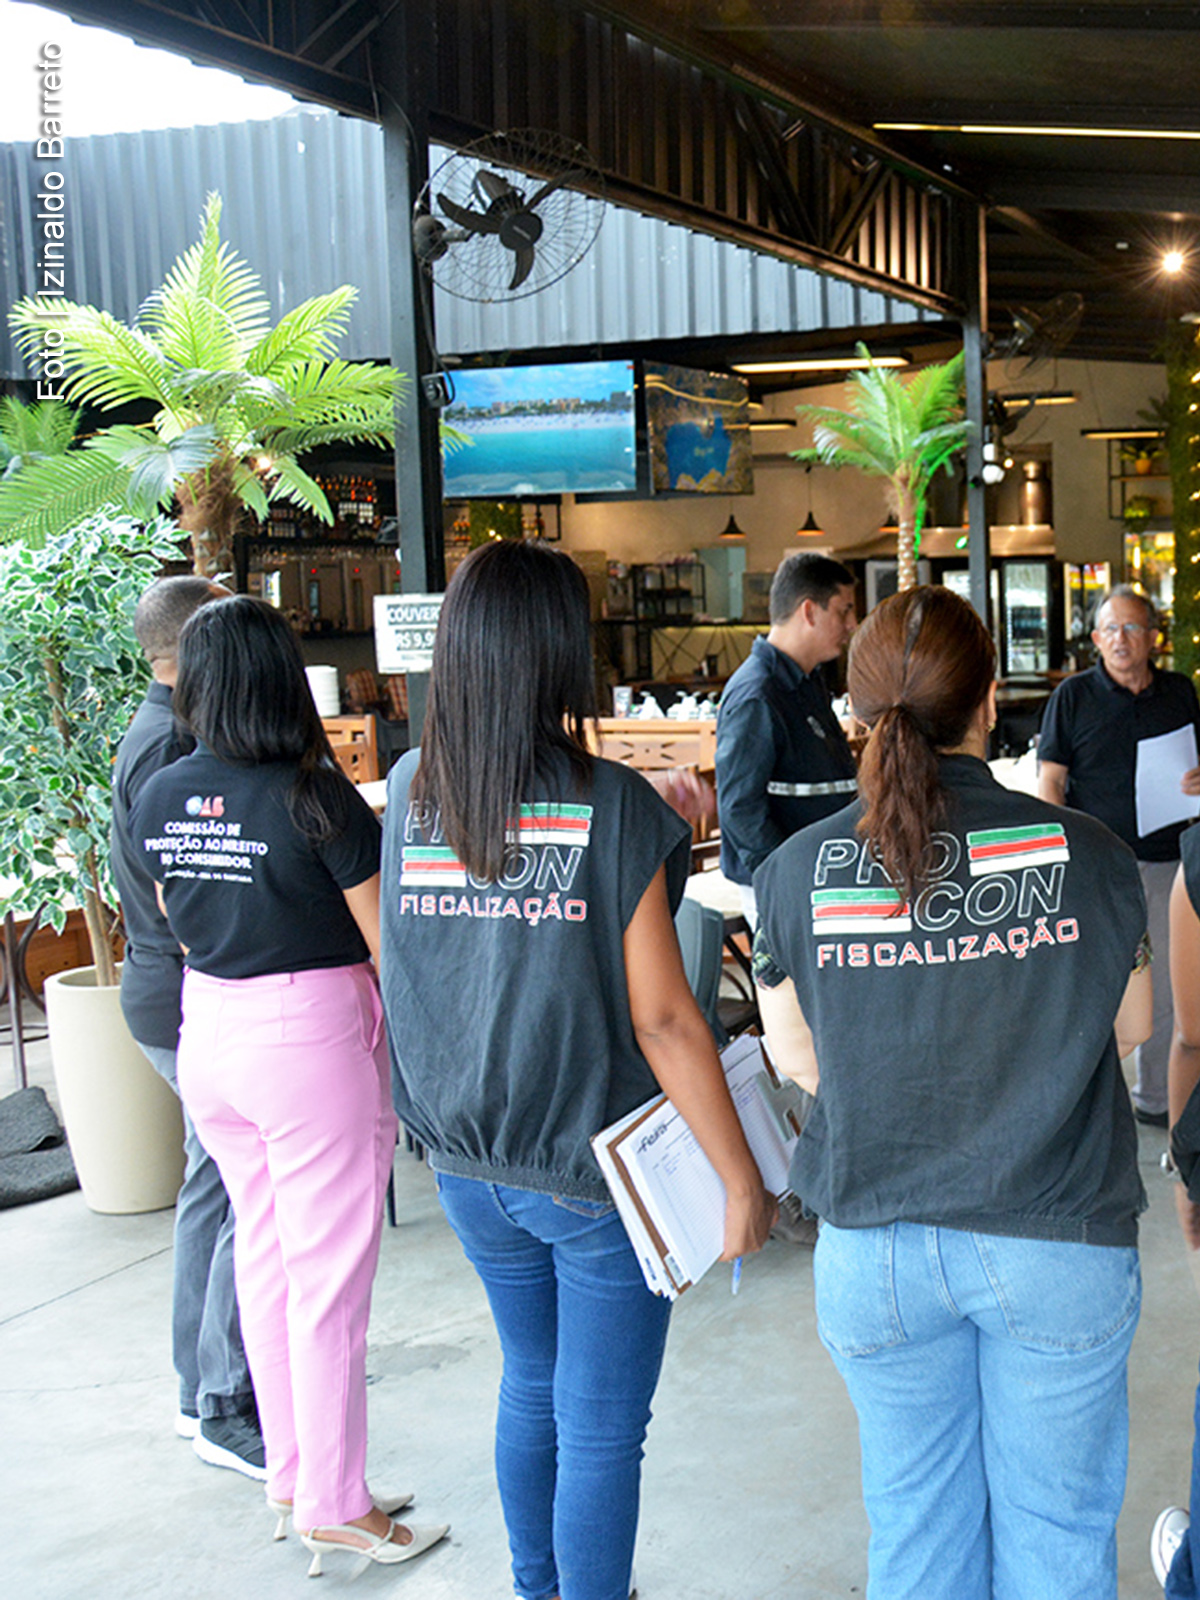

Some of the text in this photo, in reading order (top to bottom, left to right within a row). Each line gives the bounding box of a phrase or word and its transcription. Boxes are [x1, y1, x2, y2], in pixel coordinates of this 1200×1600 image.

[388, 606, 440, 623] COUVER
[413, 631, 434, 649] 9,9
[164, 820, 241, 837] COMISSÃO DE
[144, 835, 202, 853] PROTEÇÃO
[204, 838, 221, 851] AO
[914, 864, 1066, 932] CON
[400, 892, 587, 926] FISCALIZAÇÃO
[816, 917, 1080, 968] FISCALIZAÇÃO
